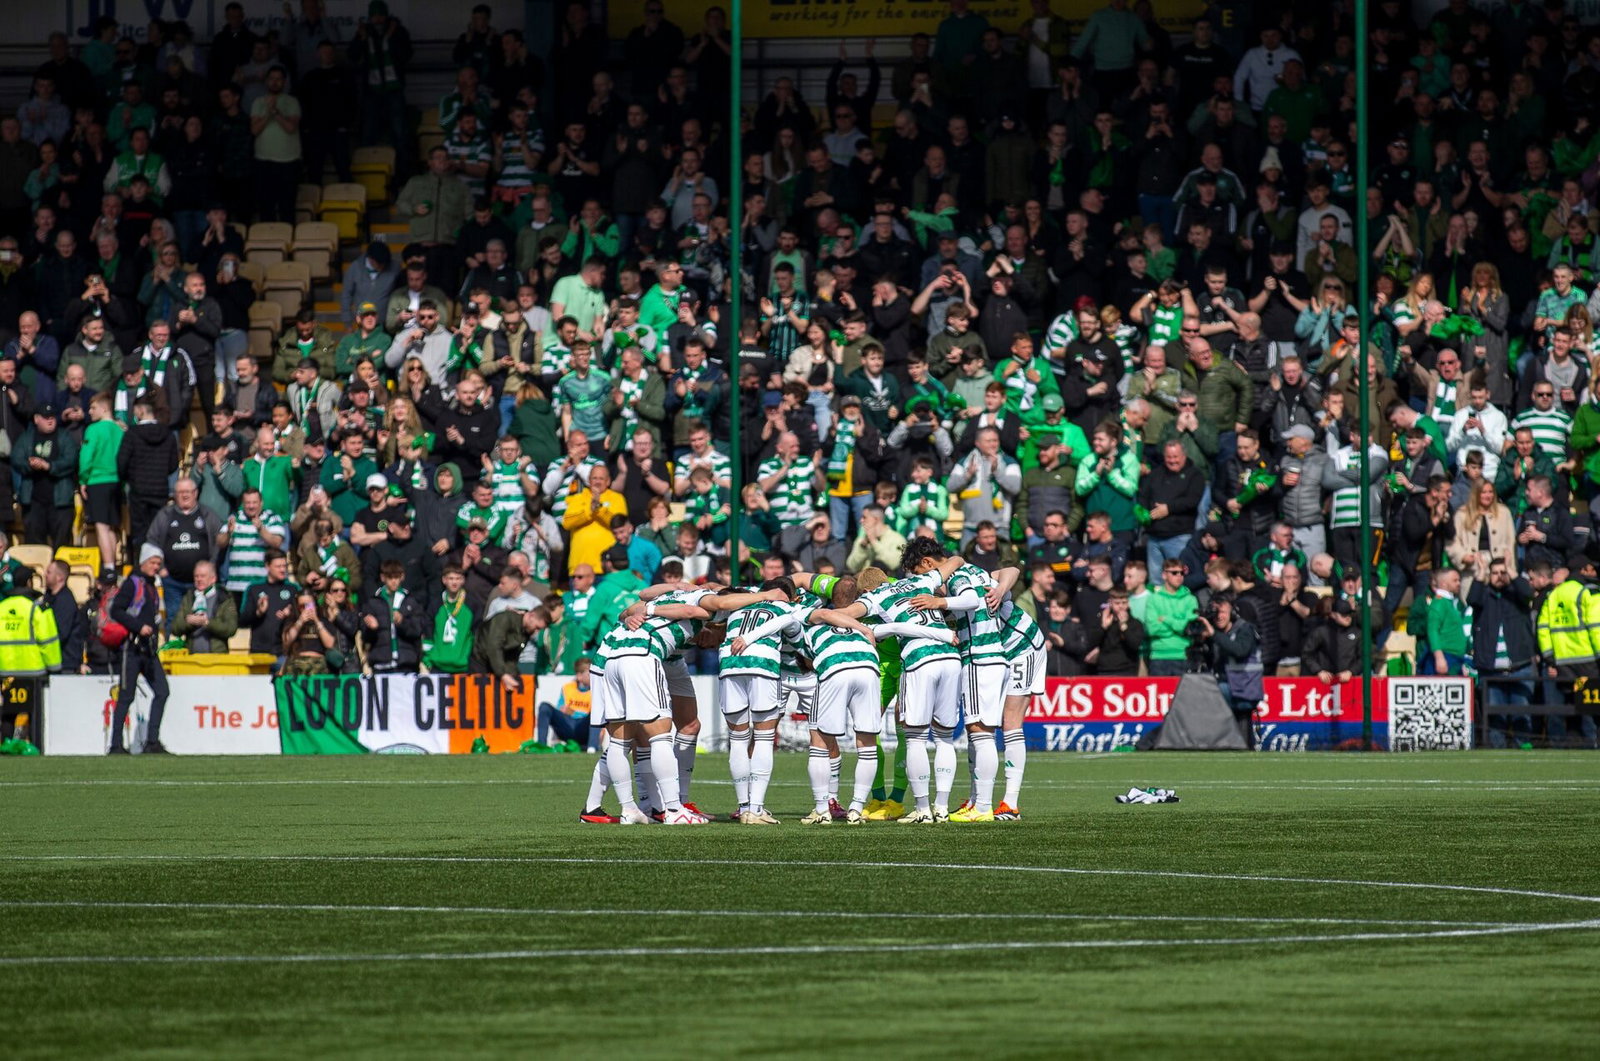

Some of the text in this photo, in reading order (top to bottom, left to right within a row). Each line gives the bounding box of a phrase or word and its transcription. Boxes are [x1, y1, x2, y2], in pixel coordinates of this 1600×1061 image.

[769, 6, 839, 28] working
[844, 5, 870, 27] for
[876, 6, 903, 19] the
[1221, 8, 1233, 27] E
[1013, 663, 1024, 681] 5
[9, 687, 28, 704] 10
[285, 676, 524, 732] LUTON CELTIC
[1278, 683, 1344, 717] Ltd
[1583, 689, 1600, 705] 11
[193, 704, 280, 729] The Jo
[1043, 722, 1310, 753] Worki You
